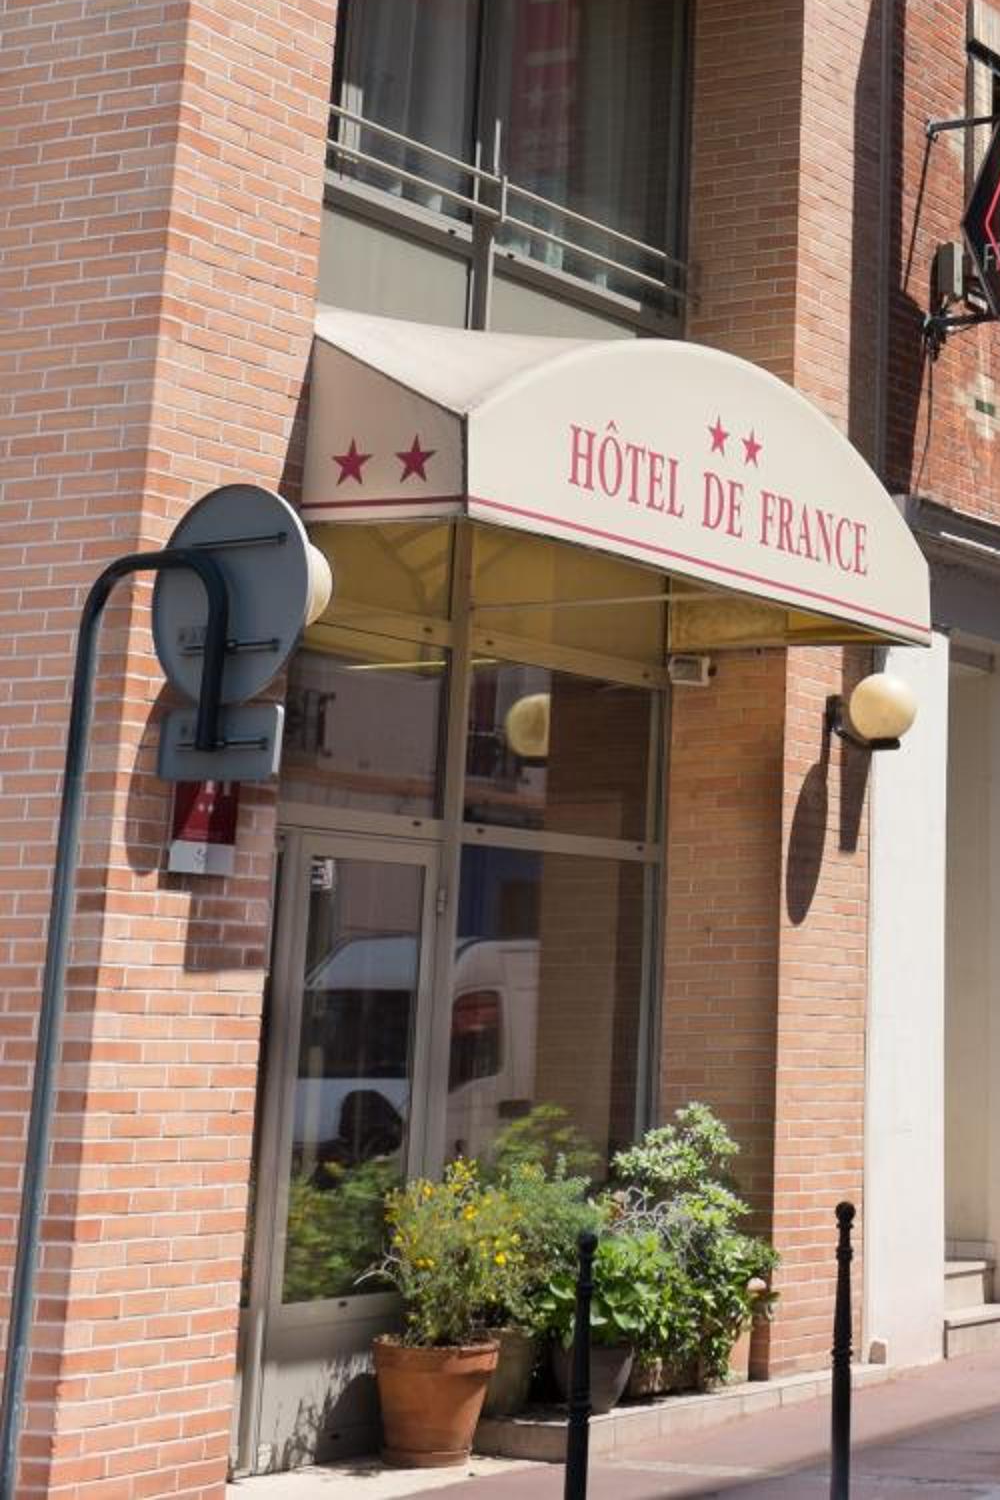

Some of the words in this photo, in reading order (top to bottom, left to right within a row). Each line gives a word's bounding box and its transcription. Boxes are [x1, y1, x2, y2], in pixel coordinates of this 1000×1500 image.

[568, 419, 685, 518] HÔTEL
[701, 470, 744, 539] DE
[759, 489, 868, 576] FRANCE
